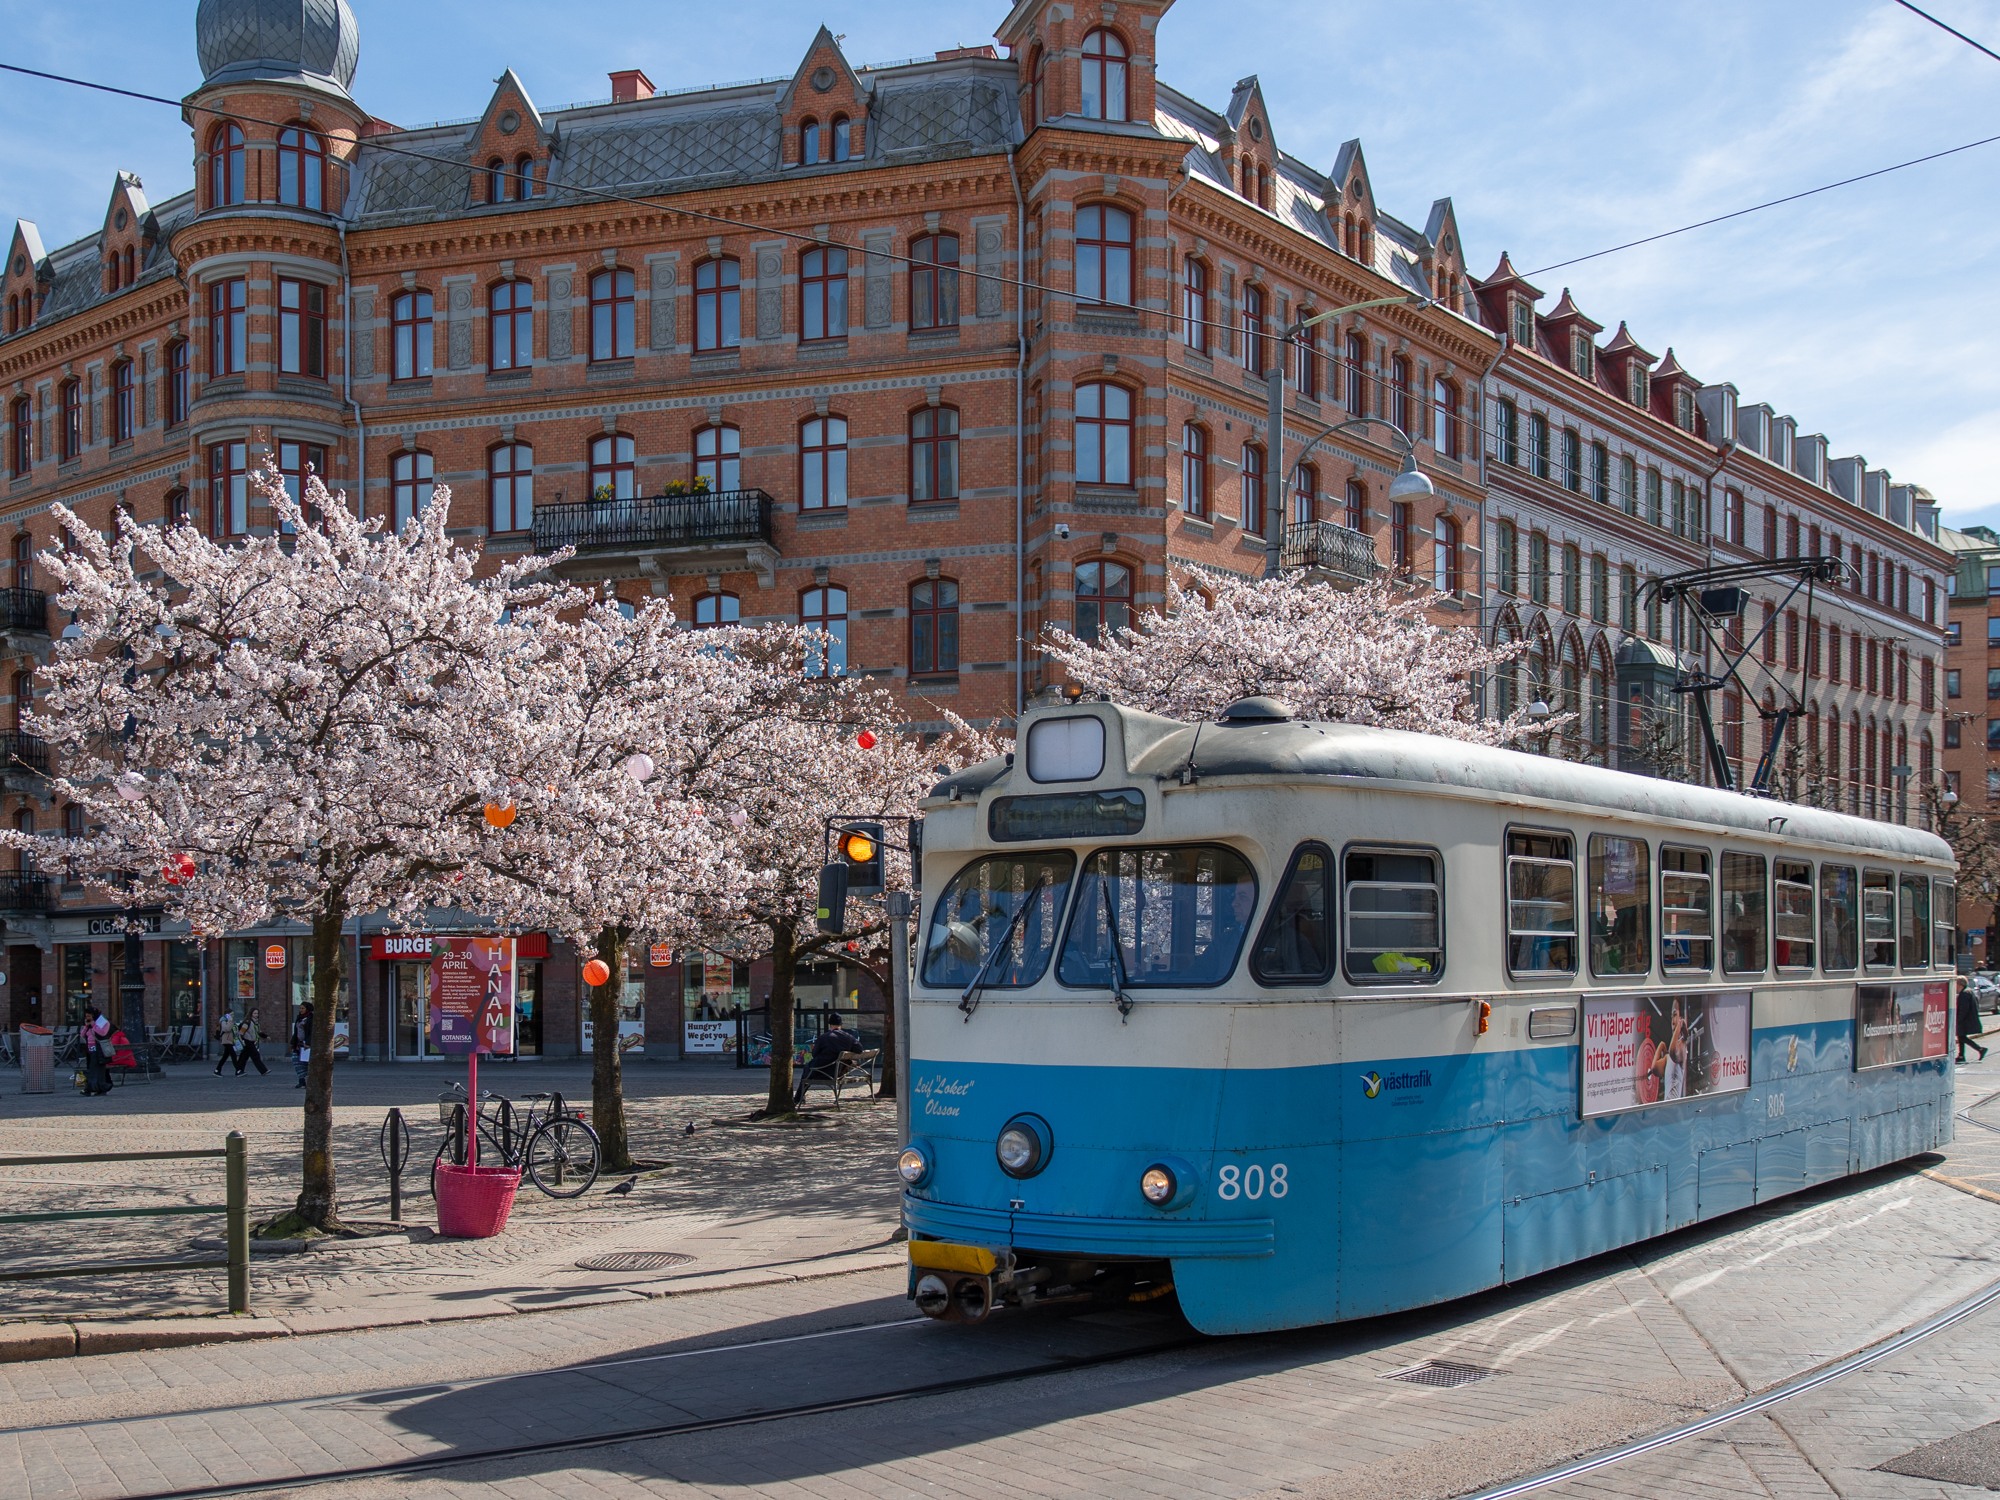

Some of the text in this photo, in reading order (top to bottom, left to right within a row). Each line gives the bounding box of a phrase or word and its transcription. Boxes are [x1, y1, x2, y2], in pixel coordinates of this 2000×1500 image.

[91, 918, 154, 934] CIGAN
[385, 937, 432, 954] BURGE
[266, 956, 285, 964] KING
[442, 961, 469, 970] APRIL
[687, 1023, 722, 1031] Hungry?
[1587, 1009, 1651, 1042] Vi hjälper dig
[700, 1032, 712, 1041] got
[1586, 1043, 1635, 1073] hitta rätt!
[1722, 1054, 1747, 1078] friskis
[914, 1076, 934, 1098] Leif
[1383, 1069, 1432, 1090] västtrafik
[925, 1098, 960, 1117] Olsson
[1768, 1093, 1785, 1118] 808
[1217, 1163, 1288, 1201] 808
